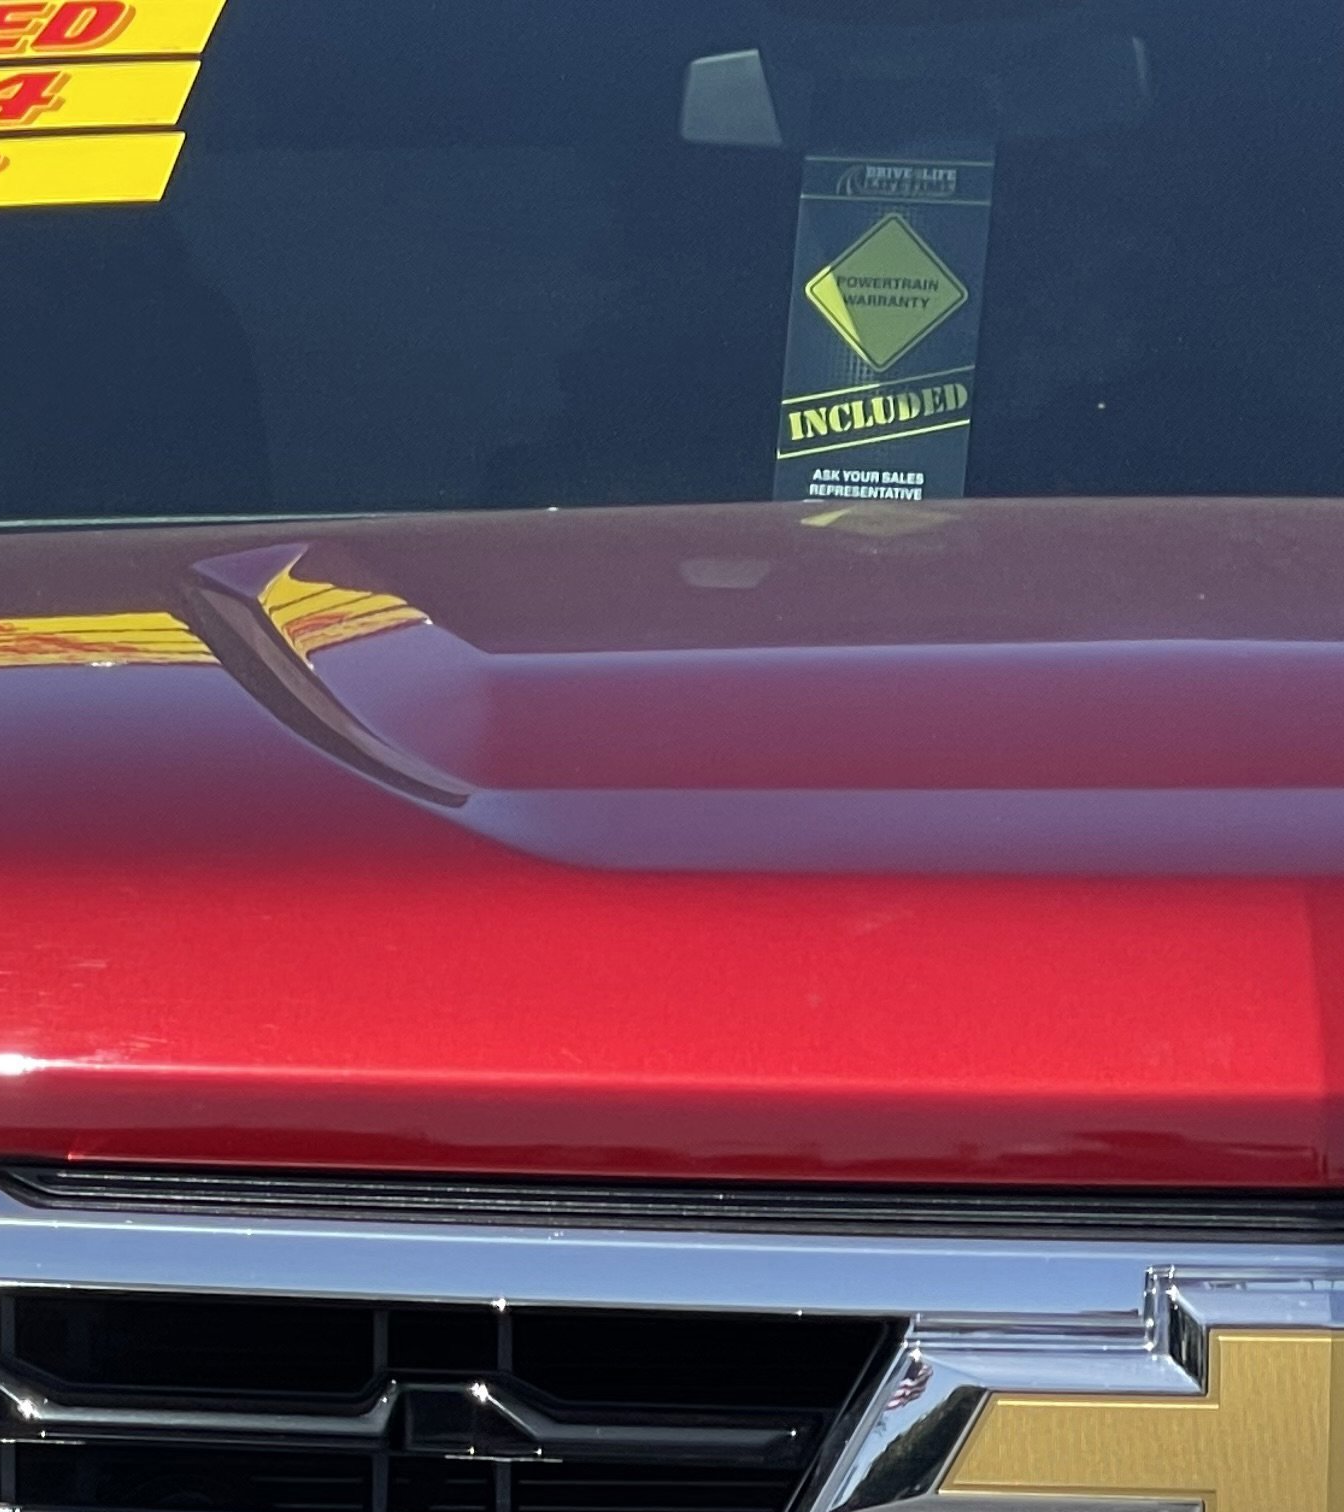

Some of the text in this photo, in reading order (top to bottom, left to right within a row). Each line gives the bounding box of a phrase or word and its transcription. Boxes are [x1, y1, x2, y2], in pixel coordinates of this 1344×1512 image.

[836, 275, 940, 292] POWERTRAIN
[843, 293, 931, 309] WARRANTY
[788, 382, 969, 442] INCLUDED
[812, 468, 925, 486] ASK YOUR SALES
[808, 483, 924, 501] REPRESENTATIVE
